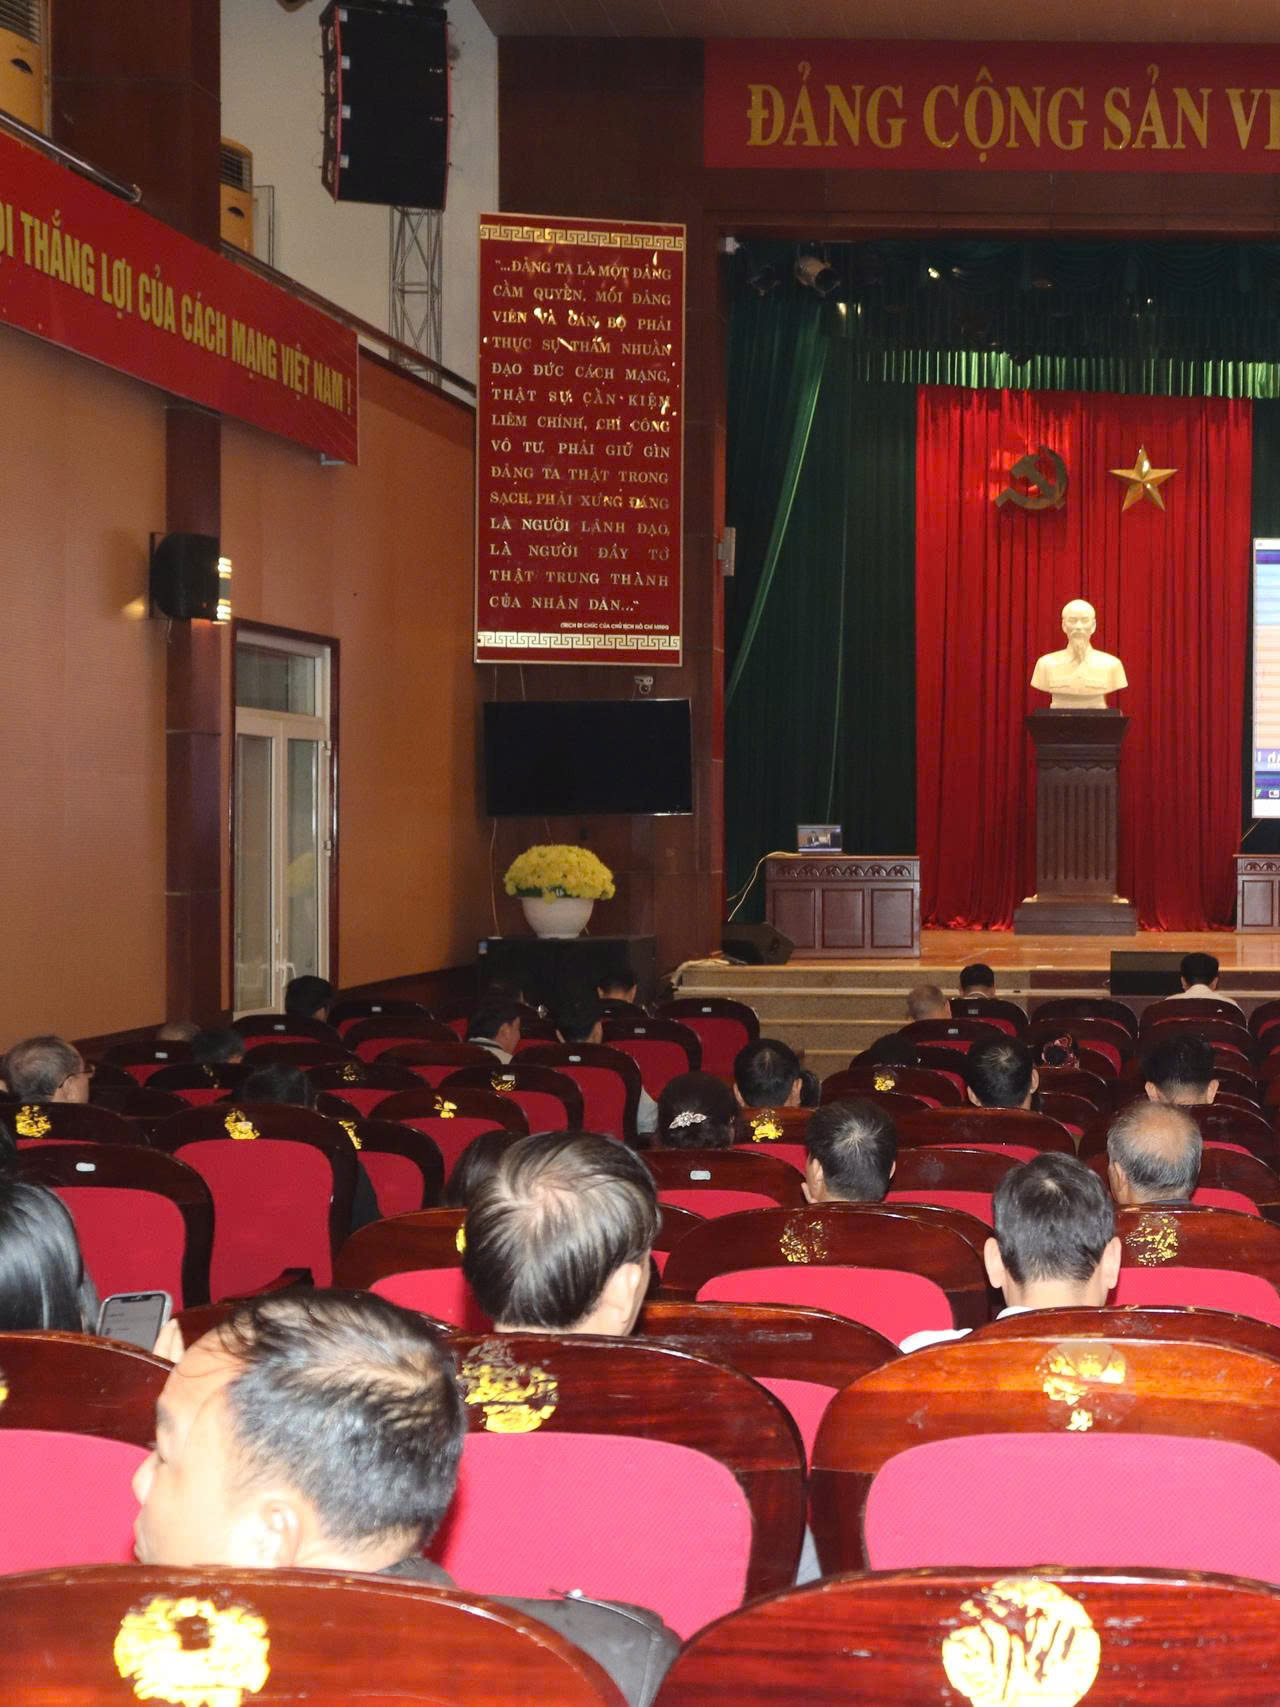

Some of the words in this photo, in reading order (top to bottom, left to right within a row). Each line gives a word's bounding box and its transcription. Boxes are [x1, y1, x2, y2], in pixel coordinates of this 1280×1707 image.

[747, 61, 906, 149] ĐẢNG
[923, 65, 1086, 162] CỘNG
[1103, 64, 1209, 152] SẢN
[555, 262, 573, 274] TA
[578, 262, 595, 276] LÀ
[599, 264, 628, 280] MỘT
[633, 264, 672, 280] ĐẢNG
[632, 292, 671, 305] ĐẢNG
[20, 207, 95, 297] THẮNG
[101, 253, 132, 320] LỢI
[138, 263, 176, 334] CỦA
[181, 291, 227, 357] CÁCH
[232, 319, 277, 379] MẠNG
[282, 342, 309, 401] VIỆT
[314, 359, 344, 409] NAM
[538, 309, 557, 325] VÀ
[608, 315, 626, 331] BỘ
[638, 318, 671, 330] PHẢI
[492, 336, 531, 352] THỰC
[542, 339, 560, 354] SỰ
[492, 363, 522, 377] ĐẠO
[533, 362, 564, 376] ĐỨC
[575, 364, 614, 379] CÁCH
[492, 387, 536, 403] THẬT
[491, 412, 527, 427] LIÊM
[596, 416, 620, 430] CHÍ
[631, 417, 670, 432] CÔNG
[491, 437, 511, 452] VÔ
[558, 440, 594, 455] PHẢI
[643, 443, 670, 458] GÌN
[491, 463, 533, 479] ĐẢNG
[542, 468, 560, 479] TA
[568, 467, 609, 484] THẬT
[618, 471, 668, 483] TRONG
[536, 490, 572, 505] PHẢI
[490, 516, 511, 530] LÀ
[522, 516, 569, 532] NGƯỜI
[490, 541, 512, 555] LÀ
[528, 542, 578, 558] NGƯỜI
[490, 568, 534, 584] THẬT
[546, 572, 600, 584] TRUNG
[610, 571, 668, 586] THÀNH
[489, 593, 520, 608] CỦA
